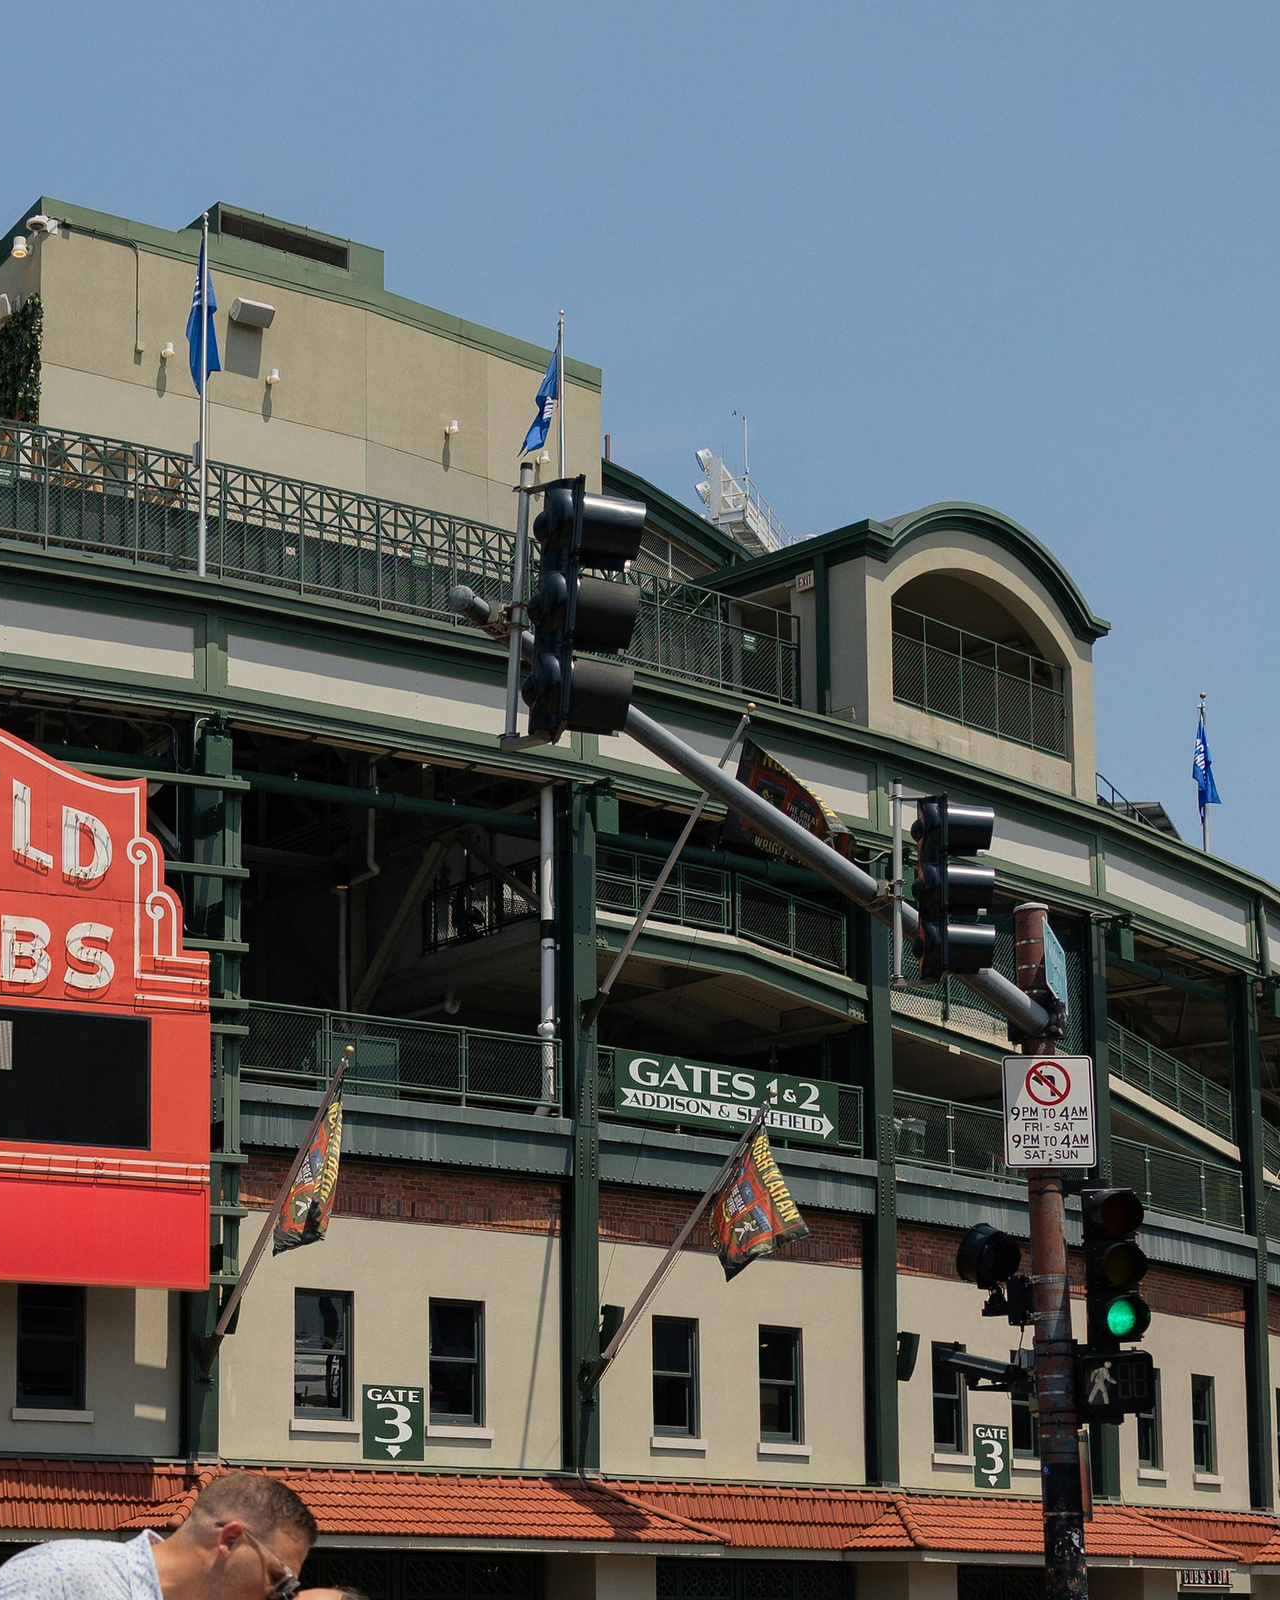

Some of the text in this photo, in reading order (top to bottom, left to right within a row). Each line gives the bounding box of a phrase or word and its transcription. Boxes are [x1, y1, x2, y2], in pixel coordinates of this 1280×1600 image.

[786, 803, 799, 815] THE
[800, 807, 819, 826] GREAT
[628, 1057, 821, 1112] GATES 1 & 2
[628, 1091, 712, 1116] ADDISON
[718, 1104, 730, 1119] &
[1042, 1108, 1056, 1119] TO
[1024, 1122, 1042, 1131] FRI
[1053, 1122, 1074, 1131] SAT
[1043, 1136, 1057, 1146] TO
[761, 1173, 800, 1223] KAHAN
[367, 1388, 420, 1403] GATE
[374, 1403, 413, 1444] 3
[975, 1427, 1007, 1440] GATE
[981, 1440, 1004, 1475] 3
